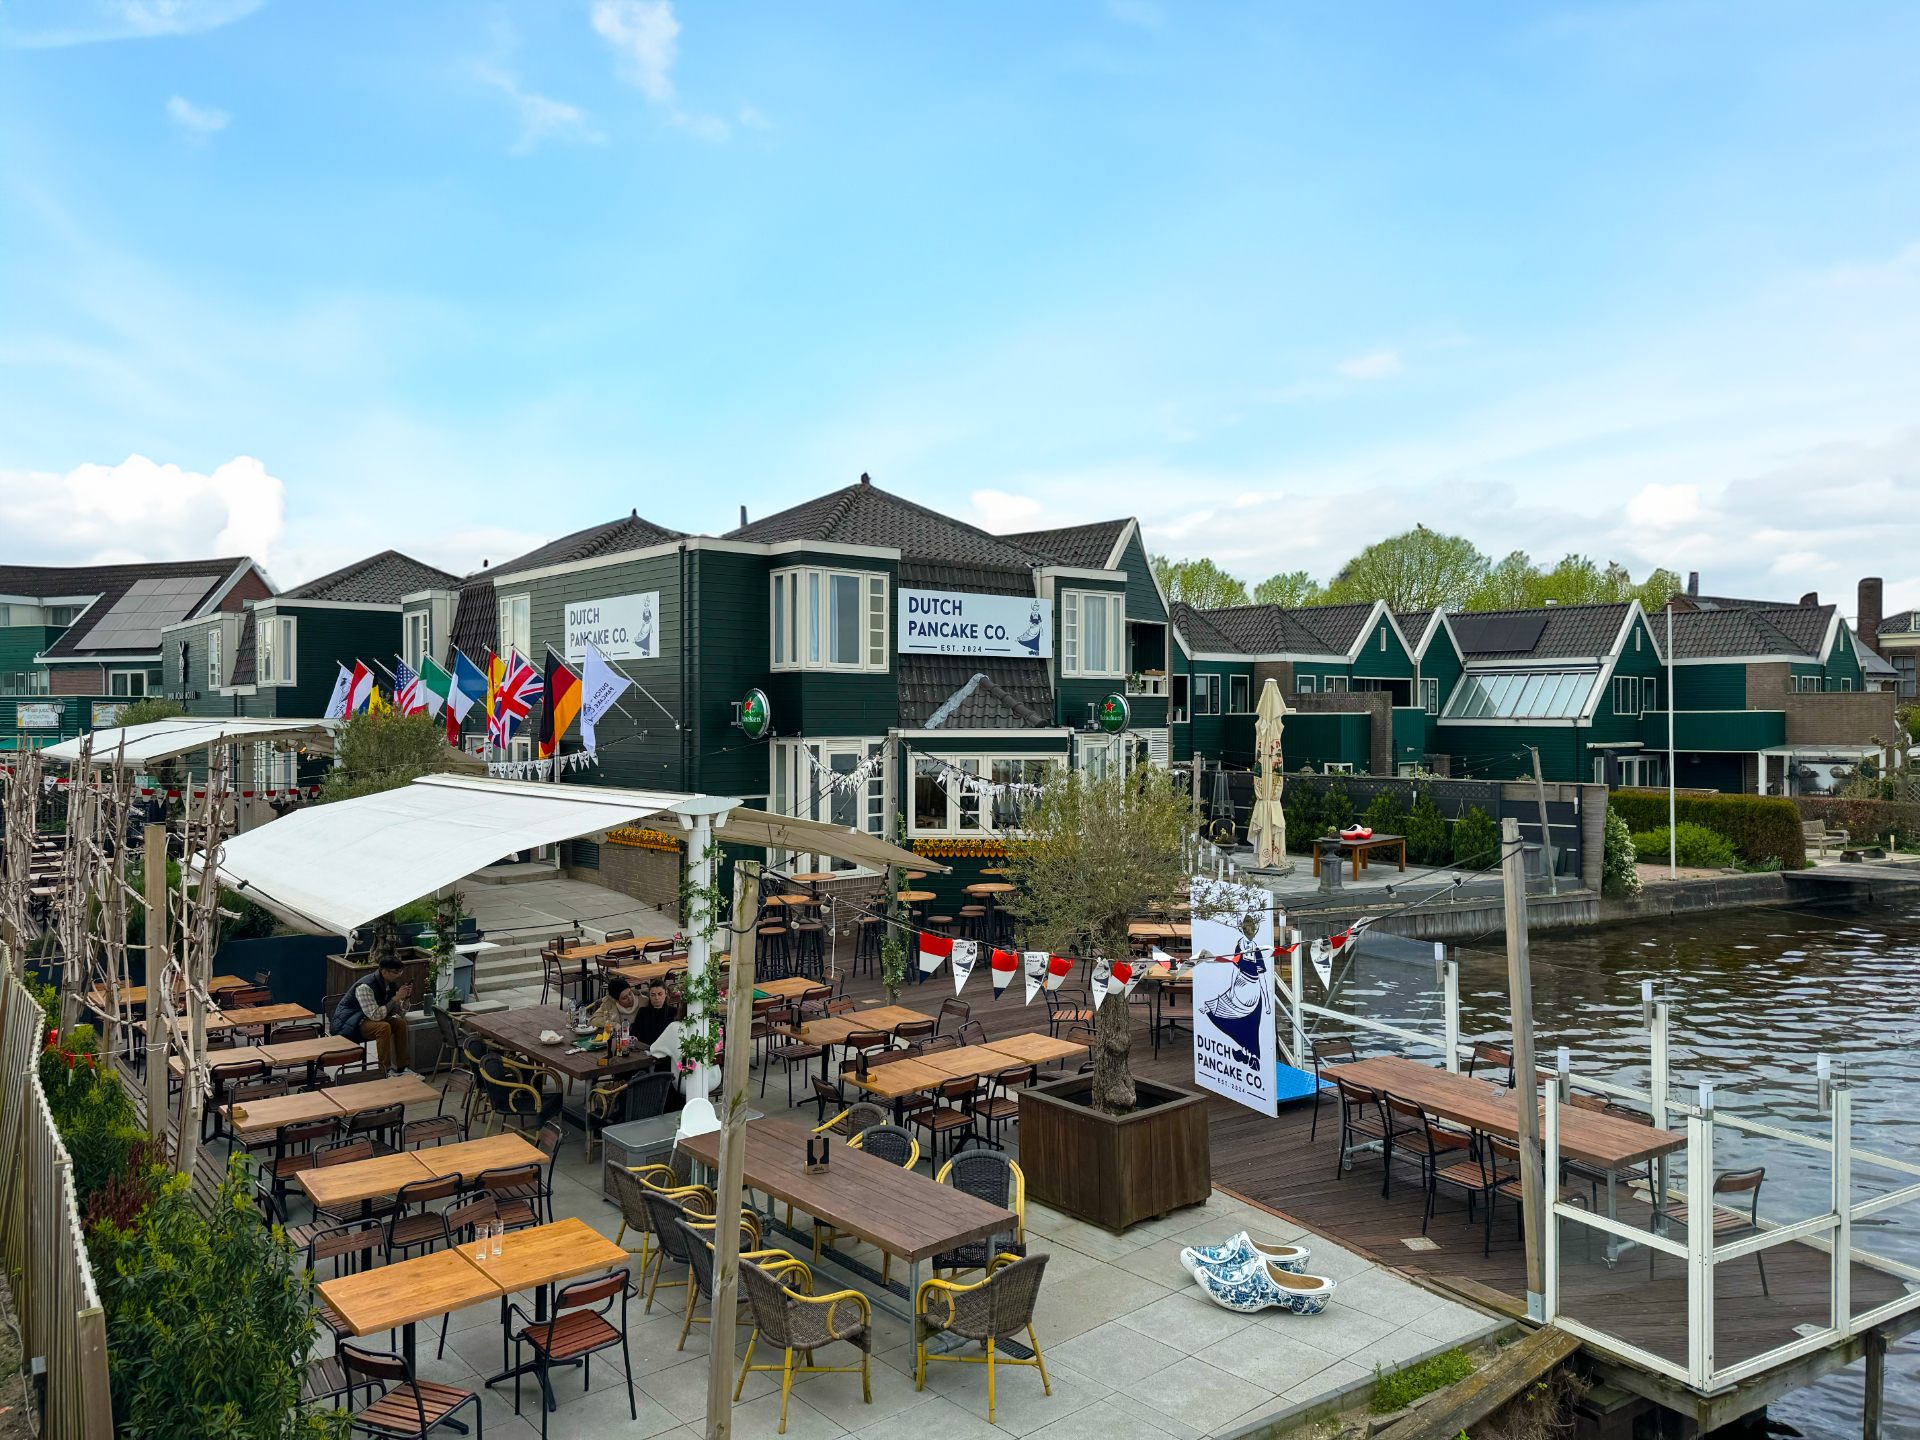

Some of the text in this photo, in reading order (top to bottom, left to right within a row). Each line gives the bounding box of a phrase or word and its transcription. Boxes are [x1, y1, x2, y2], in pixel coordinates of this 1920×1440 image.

[909, 597, 962, 616] DUTCH
[570, 607, 600, 626] DUTCH
[612, 628, 629, 643] CO.
[909, 621, 1009, 640] PANCAKE CO.
[940, 644, 959, 652] EST.
[1197, 1035, 1231, 1060] DUTCH
[1197, 1052, 1265, 1091] PANCAKE CO.
